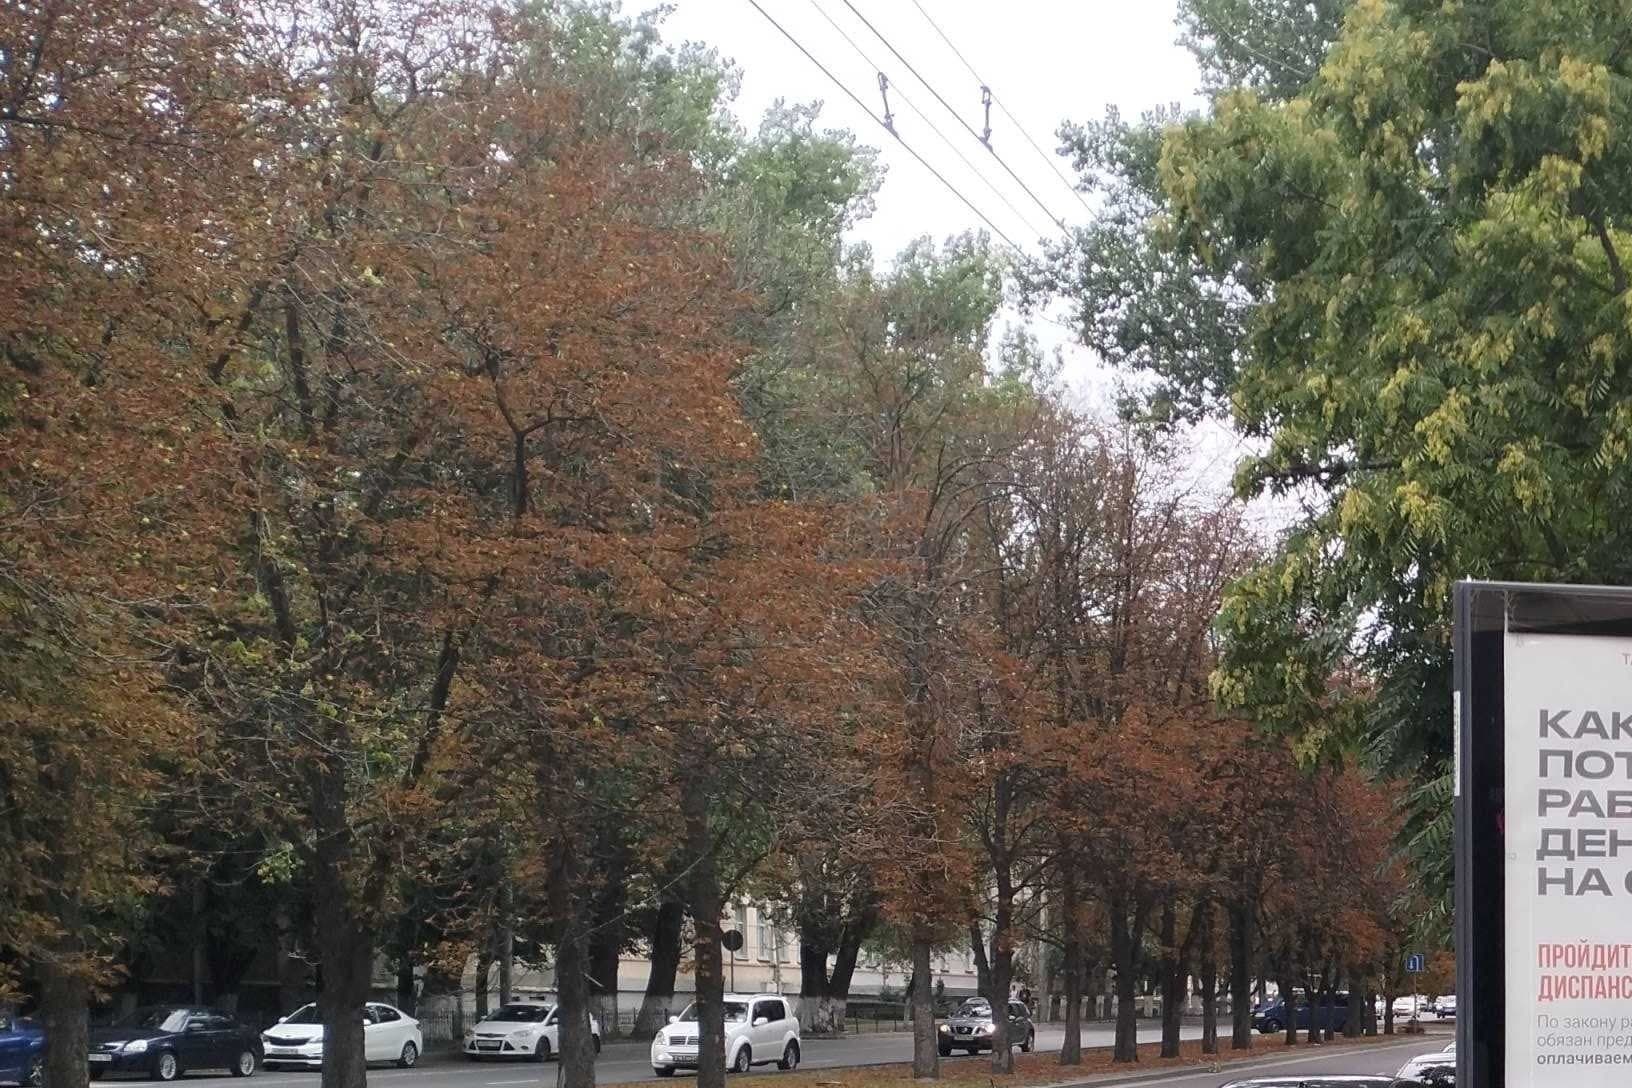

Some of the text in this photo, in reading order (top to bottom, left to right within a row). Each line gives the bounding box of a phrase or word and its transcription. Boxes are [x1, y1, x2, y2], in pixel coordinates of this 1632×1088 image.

[1538, 867, 1613, 897] НА
[1537, 1014, 1559, 1029] По
[1564, 1016, 1617, 1033] закону
[1536, 1031, 1593, 1048] обязан
